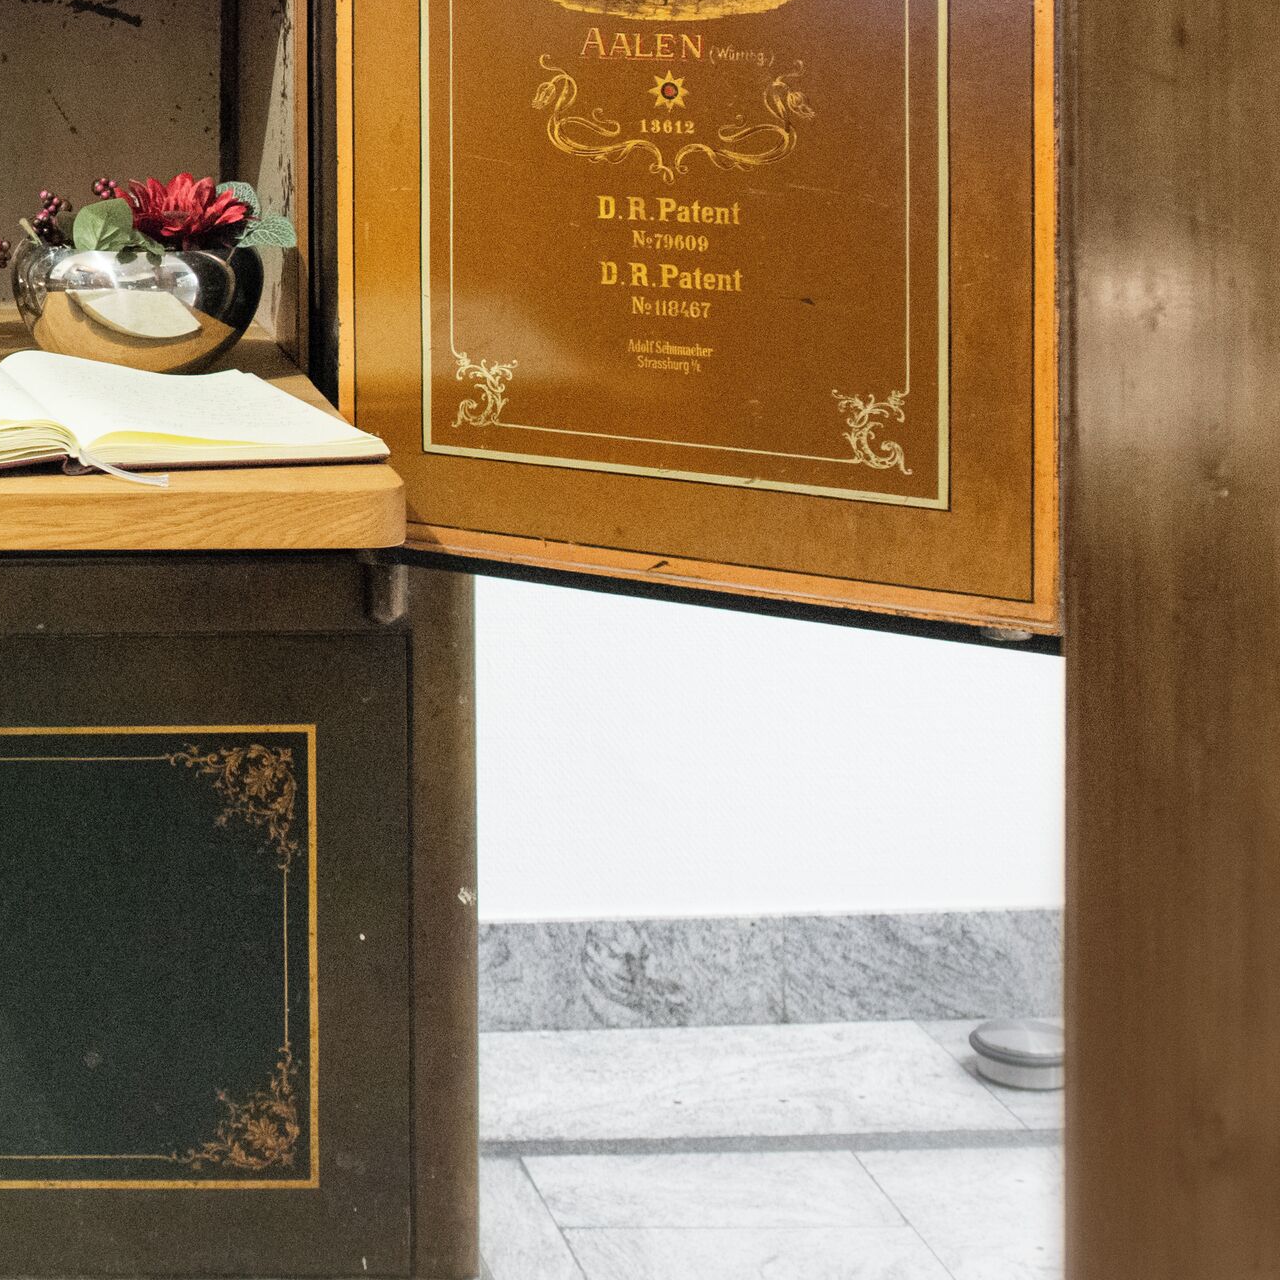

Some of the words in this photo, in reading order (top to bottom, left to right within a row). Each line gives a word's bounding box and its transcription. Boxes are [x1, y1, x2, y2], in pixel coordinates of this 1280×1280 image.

[580, 27, 704, 61] AALEN
[628, 338, 654, 354] Adolf
[655, 340, 714, 357] Schumacher
